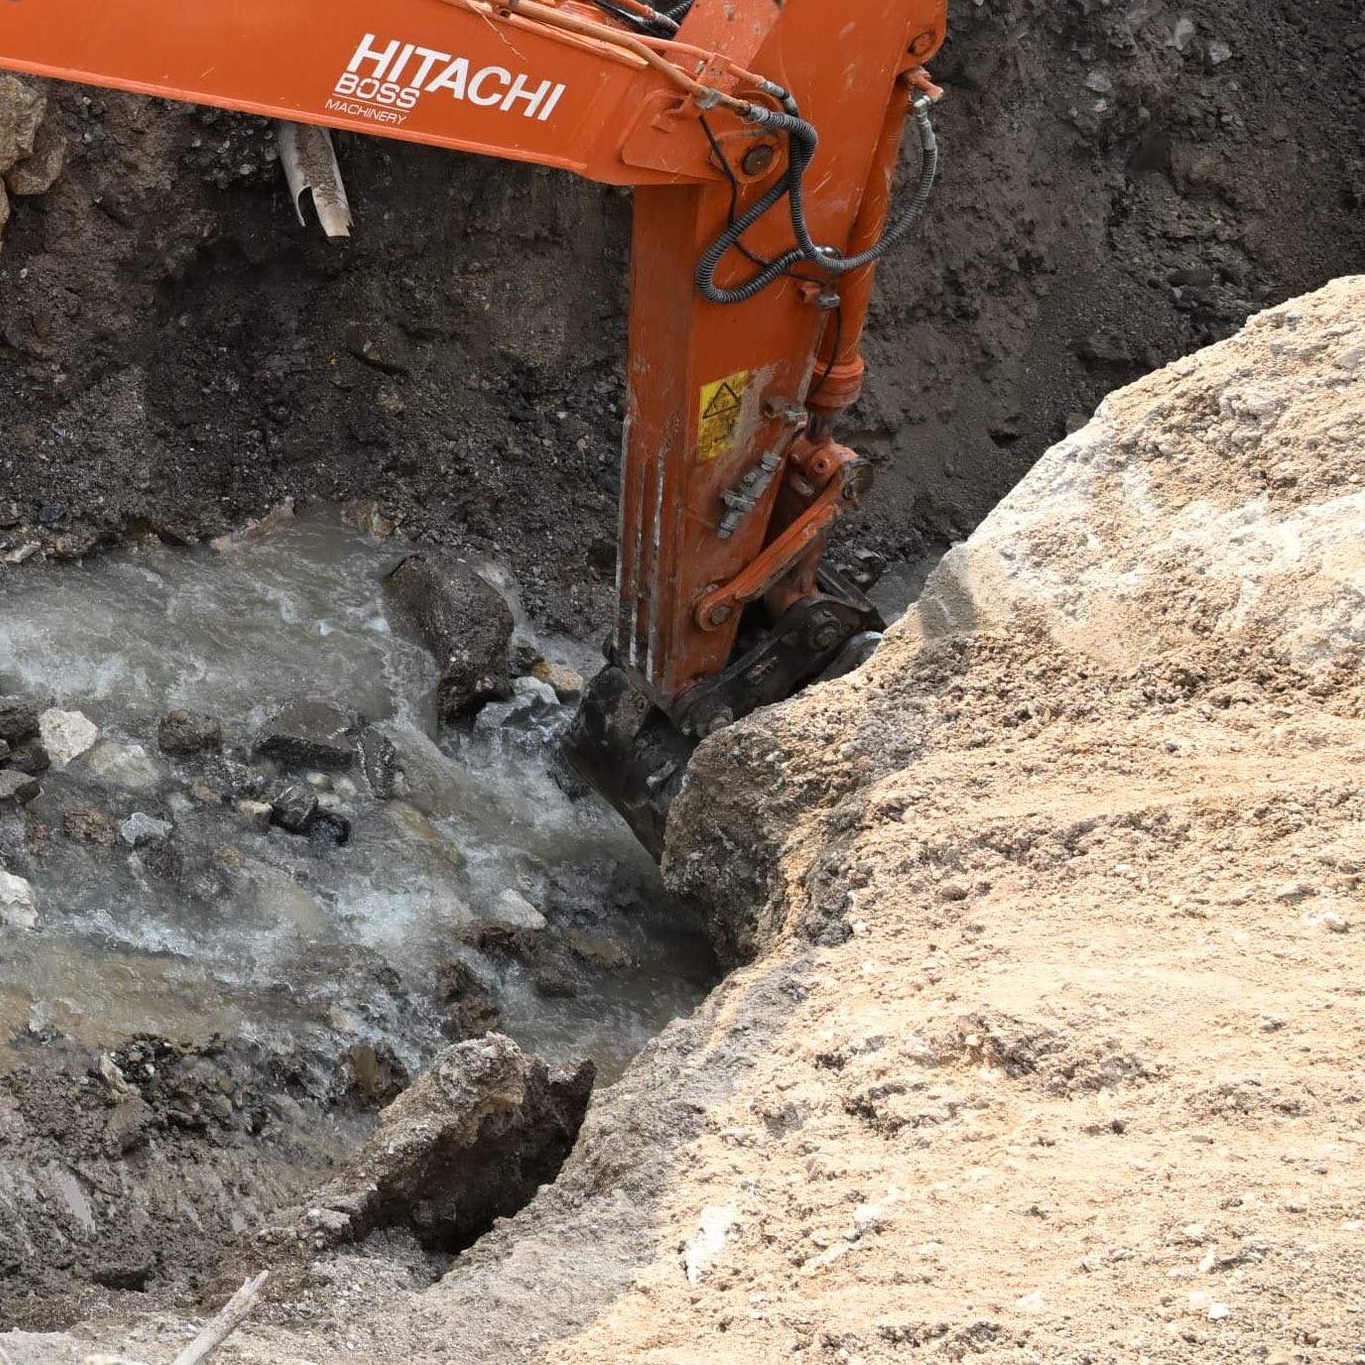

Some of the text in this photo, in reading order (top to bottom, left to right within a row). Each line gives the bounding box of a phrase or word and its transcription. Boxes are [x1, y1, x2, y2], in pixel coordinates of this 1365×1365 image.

[334, 73, 420, 109] BOSS
[346, 33, 566, 121] HITACHI
[325, 99, 407, 125] MACHINERY
